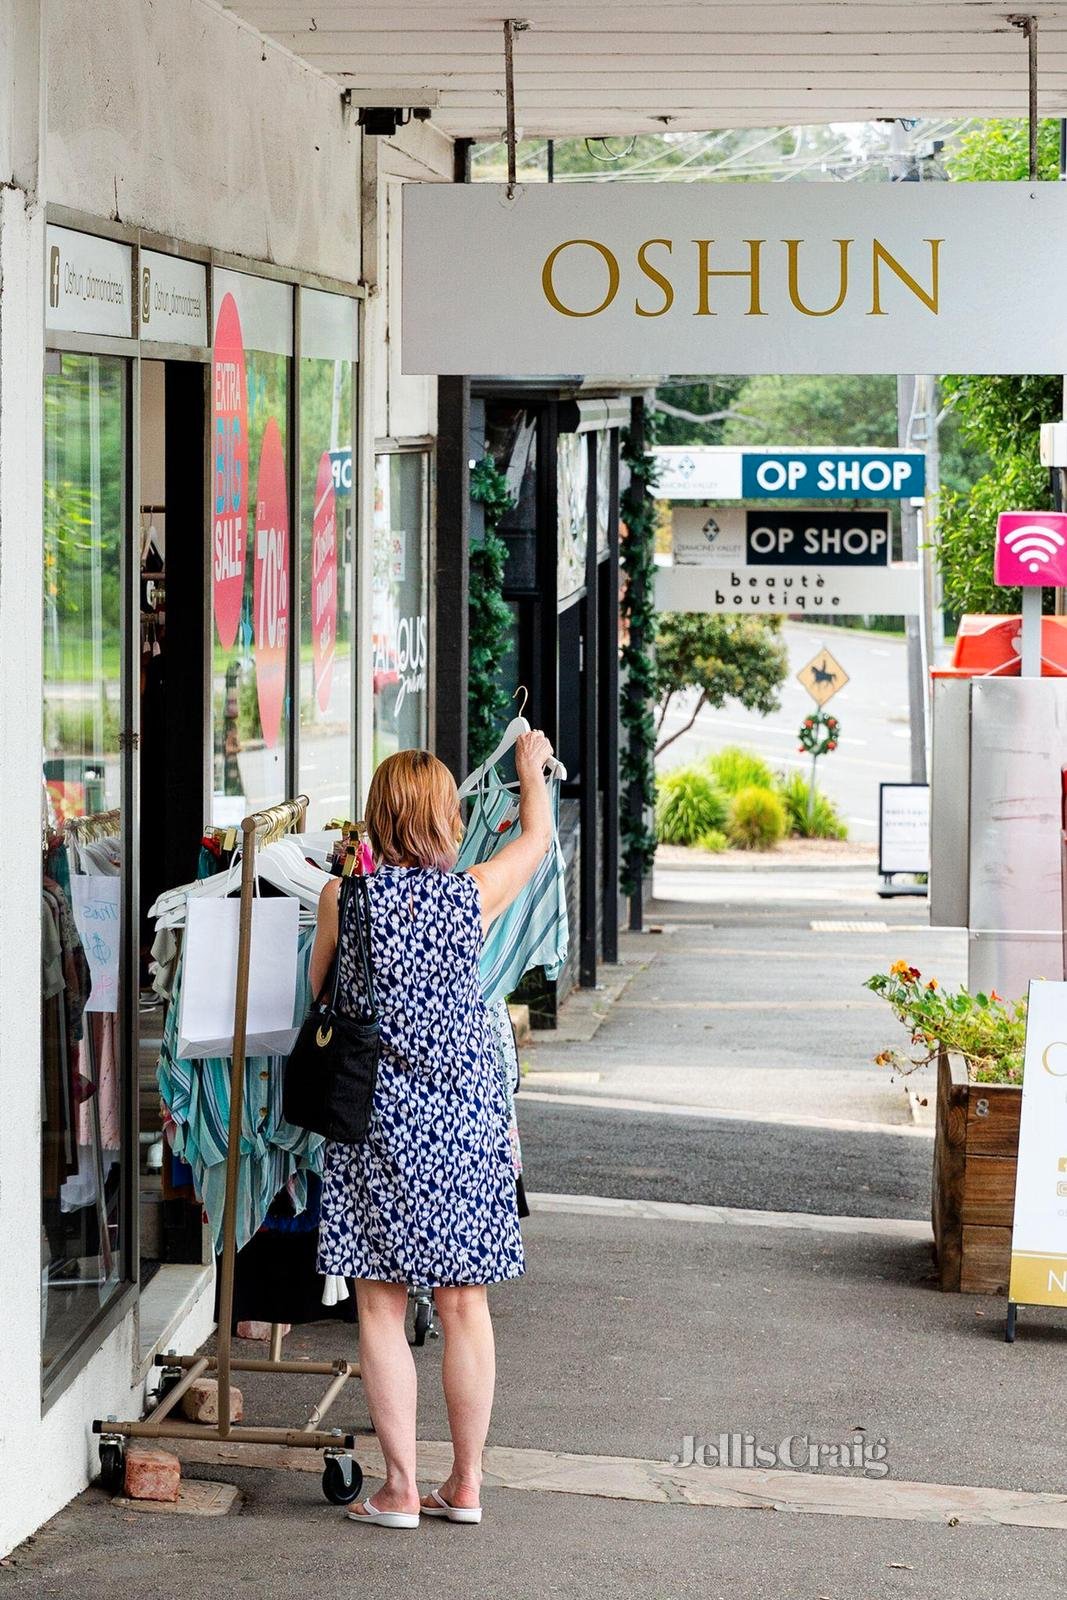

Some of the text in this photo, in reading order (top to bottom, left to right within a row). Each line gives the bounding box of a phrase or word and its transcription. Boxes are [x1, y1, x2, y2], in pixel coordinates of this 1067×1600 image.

[541, 238, 946, 317] OSHUN
[215, 362, 242, 411] EXTRA
[215, 416, 242, 514] BIG
[757, 460, 912, 491] OP SHOP
[215, 517, 242, 583] SALE
[750, 527, 887, 555] OP SHOP
[257, 527, 287, 650] 70%
[715, 590, 841, 609] boutique
[975, 1098, 990, 1117] 8
